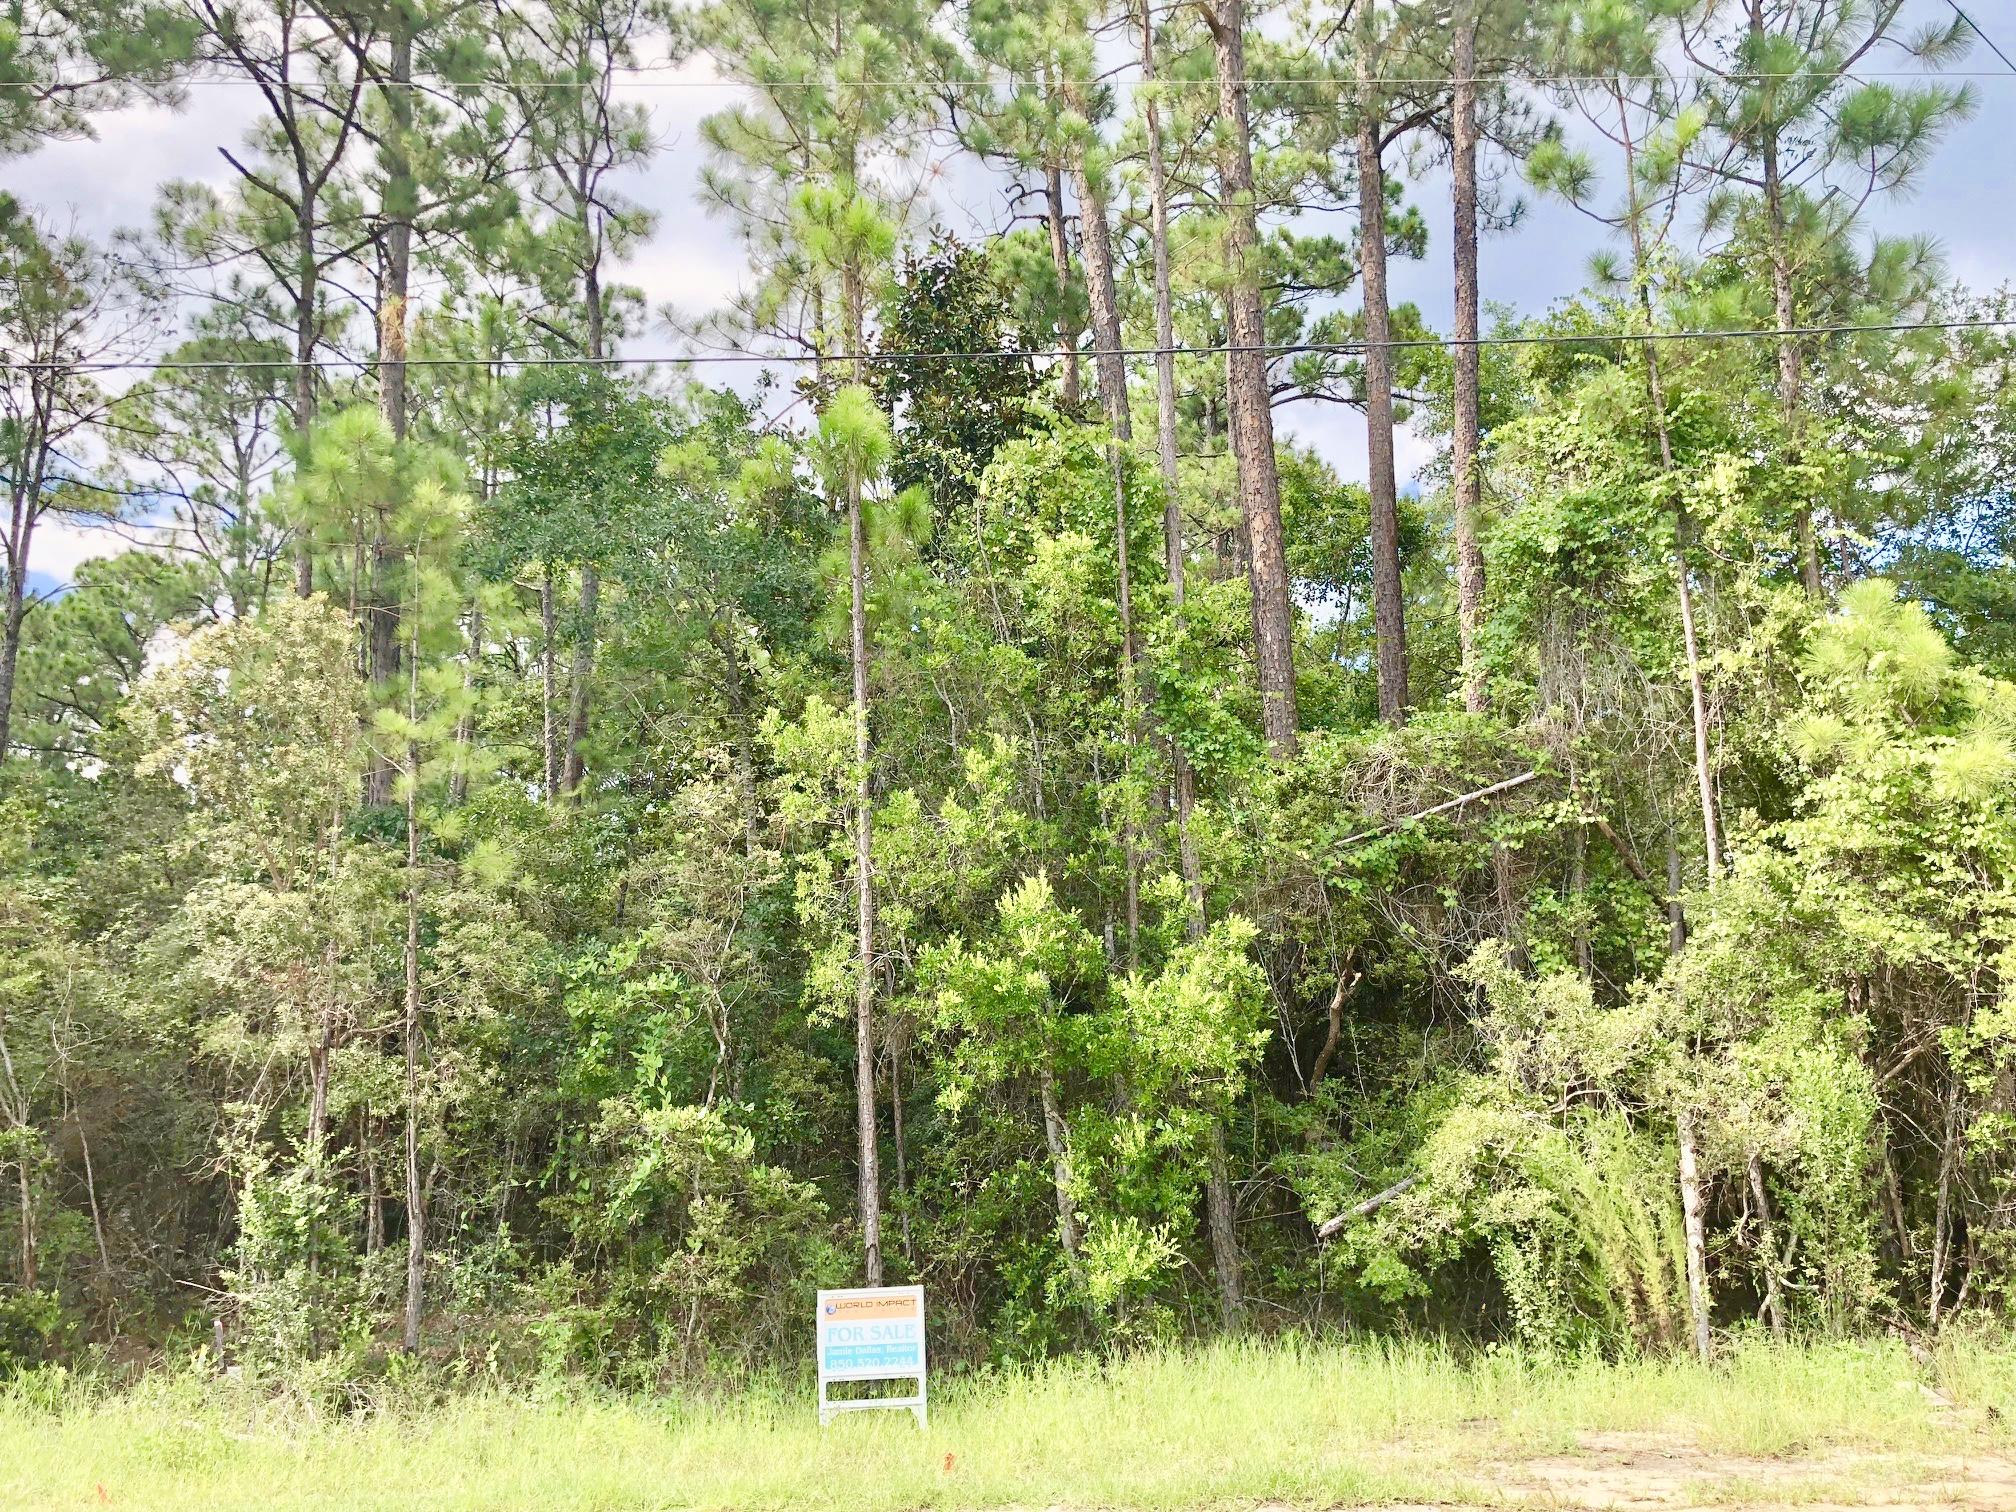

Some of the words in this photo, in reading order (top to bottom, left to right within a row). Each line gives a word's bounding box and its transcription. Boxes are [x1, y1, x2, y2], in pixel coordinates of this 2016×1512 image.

[835, 1301, 873, 1309] WORLD
[876, 1299, 917, 1307] IMPACT
[828, 1326, 864, 1342] FOR
[870, 1324, 916, 1341] SALE
